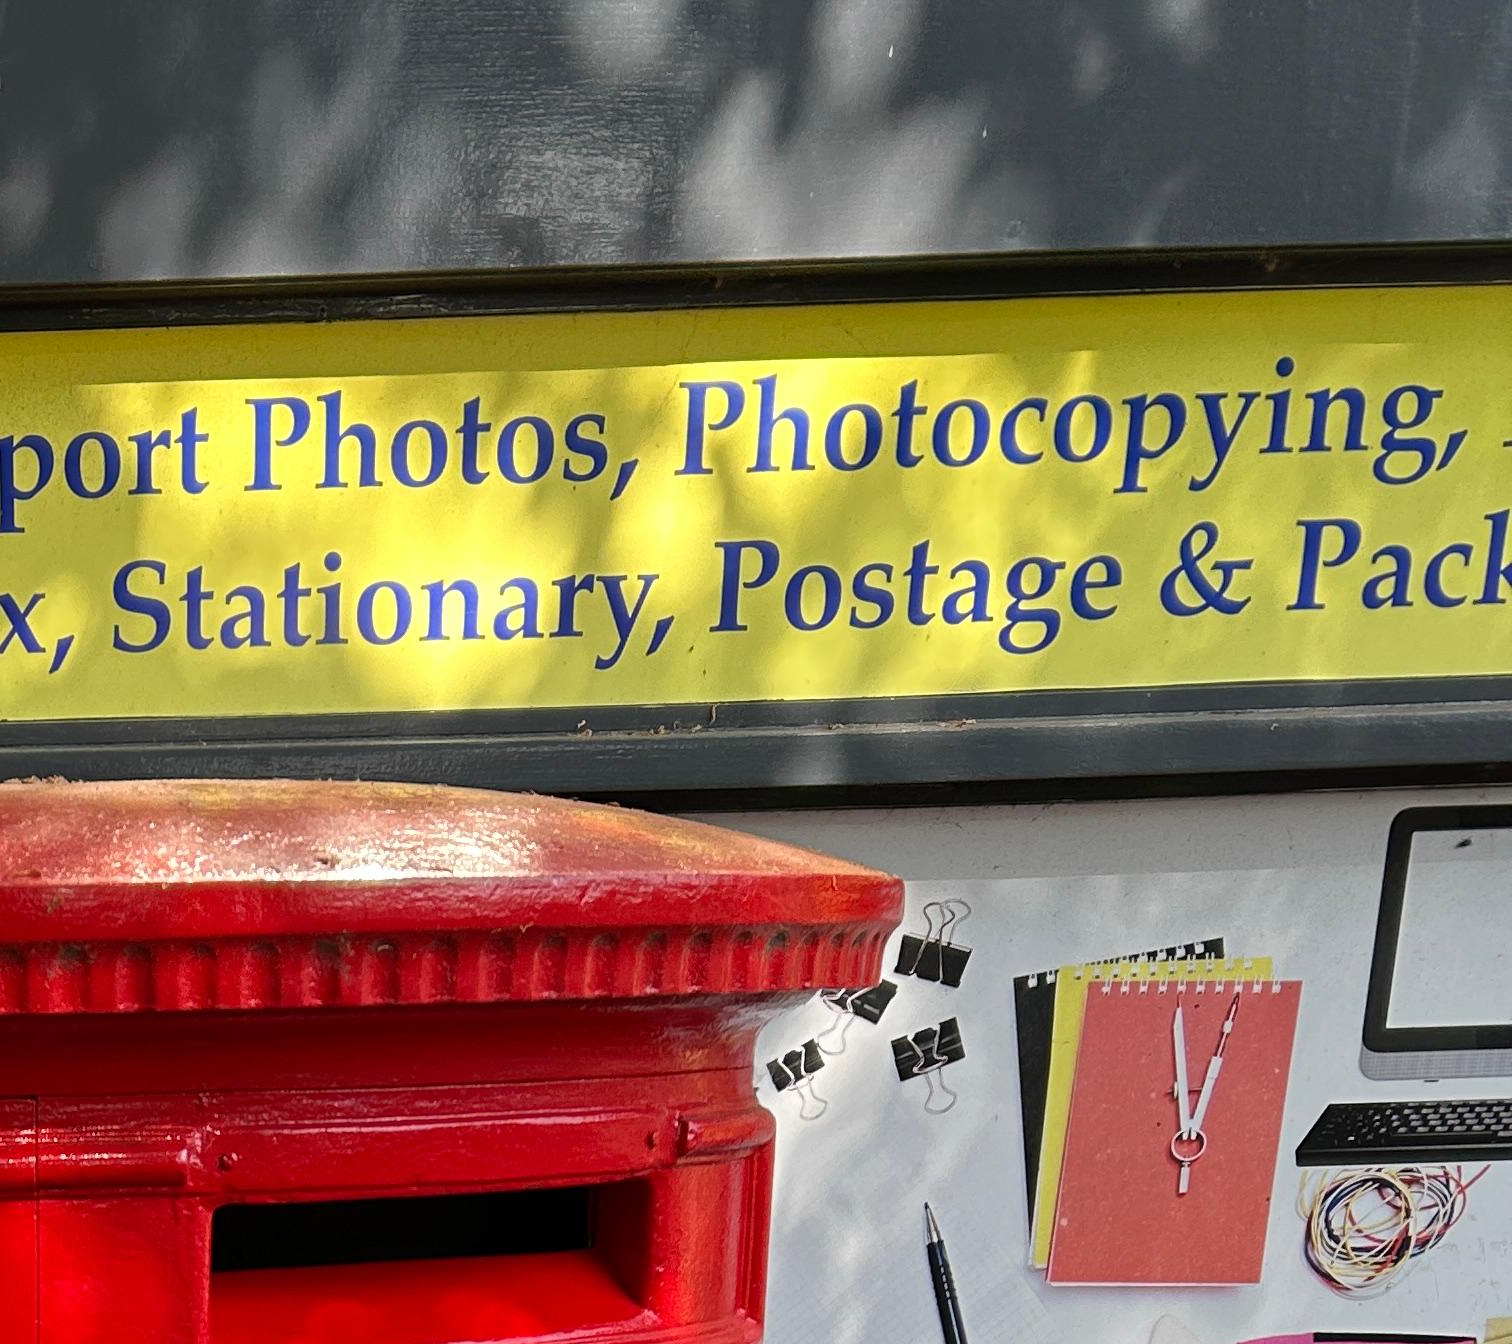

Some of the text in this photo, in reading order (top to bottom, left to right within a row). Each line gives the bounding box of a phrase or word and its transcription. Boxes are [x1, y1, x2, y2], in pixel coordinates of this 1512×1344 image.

[245, 390, 639, 500] Photos,
[675, 357, 1468, 493] Photocopying,
[113, 552, 675, 670] Stationary,
[709, 540, 1123, 655] Postage
[1160, 521, 1253, 617] &
